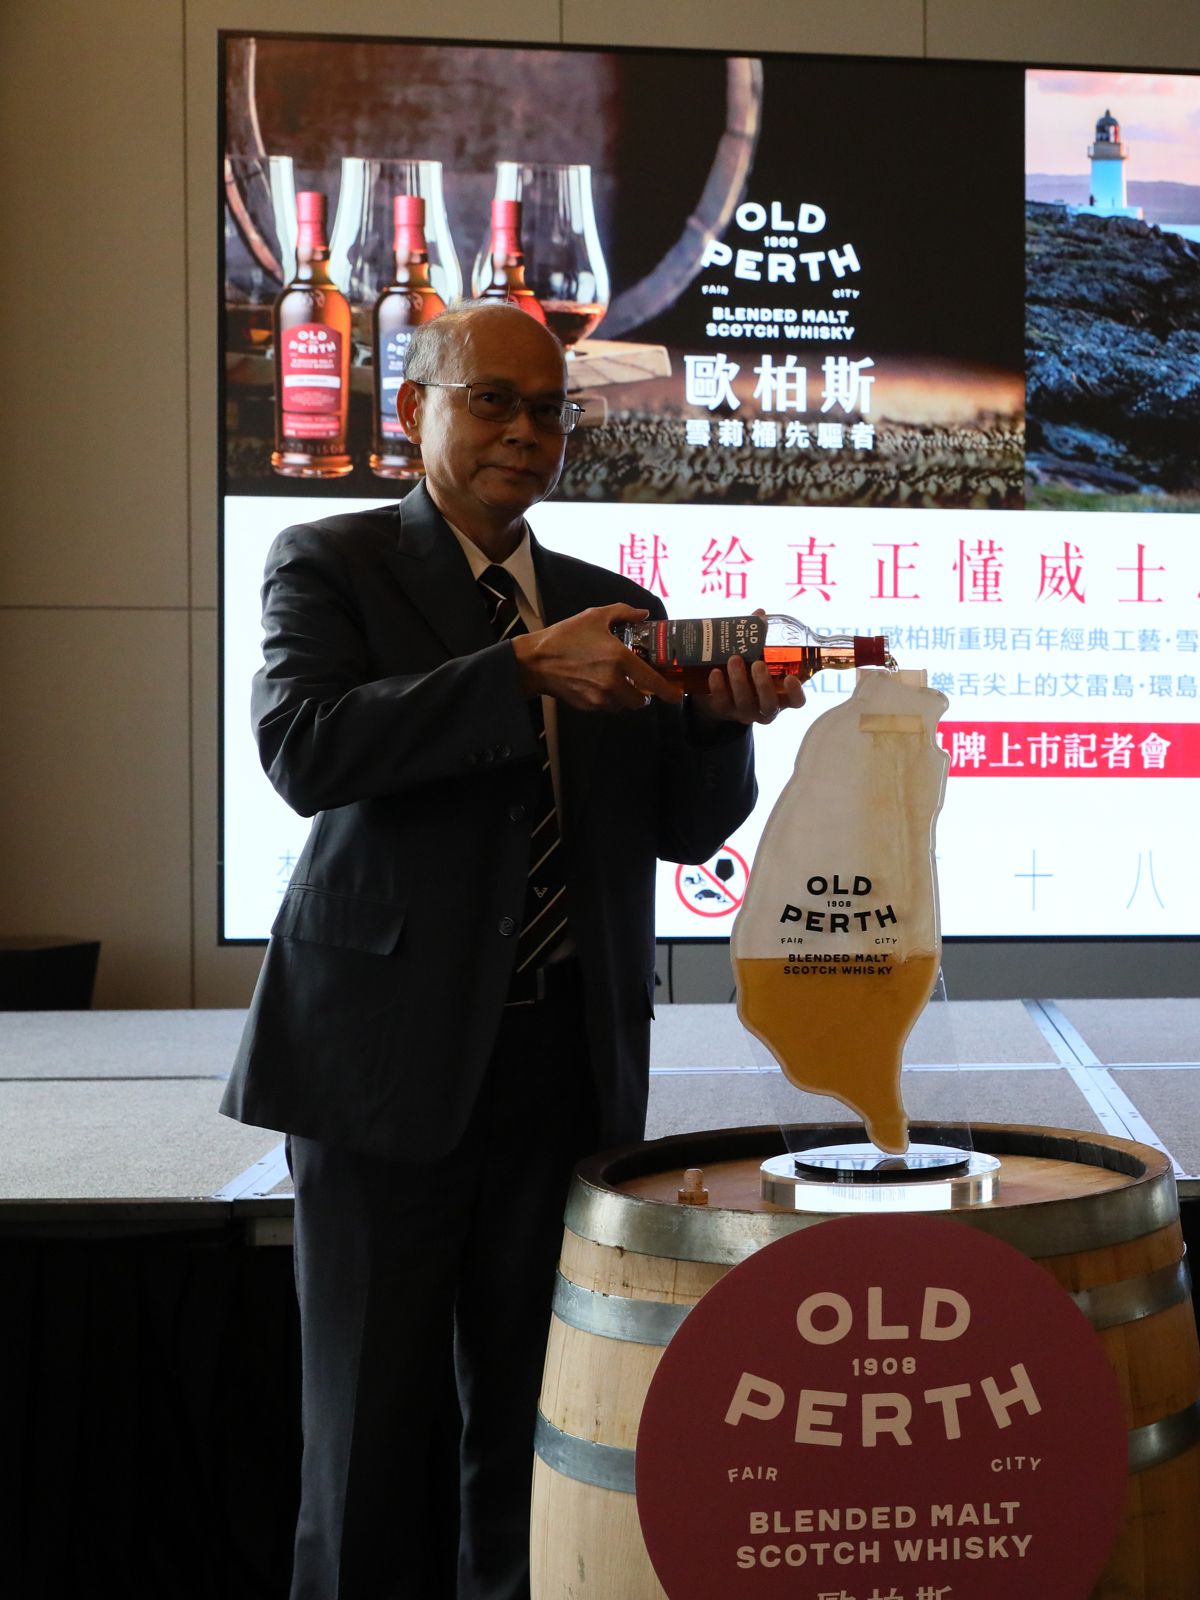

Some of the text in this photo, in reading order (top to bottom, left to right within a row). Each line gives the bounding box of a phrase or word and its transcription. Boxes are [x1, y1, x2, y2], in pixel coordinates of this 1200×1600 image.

[735, 201, 826, 233] OLD
[700, 239, 861, 283] PERTH
[702, 285, 860, 299] FAIR CITY
[712, 306, 849, 324] BLENDED MALT
[297, 330, 327, 341] OLD
[706, 323, 855, 340] SCOTCH WHISKY
[684, 353, 875, 413] 歐柏斯
[686, 419, 875, 449] 雪莉桶先驅者
[750, 623, 759, 644] OLD
[936, 731, 1171, 769] 牌上市記者會
[807, 875, 872, 896] OLD
[827, 900, 852, 908] 1908
[780, 904, 897, 933] PERTH
[784, 966, 893, 975] SCOTCH WHISKY
[788, 954, 888, 963] BLENDED MALT
[797, 1287, 971, 1345] OLD
[852, 1357, 916, 1376] 1908
[724, 1363, 1042, 1447] PERTH
[727, 1456, 1042, 1483] FAIR CITY
[750, 1501, 1021, 1535] BLENDED MALT
[736, 1534, 1033, 1569] SCOTCH WHISKY
